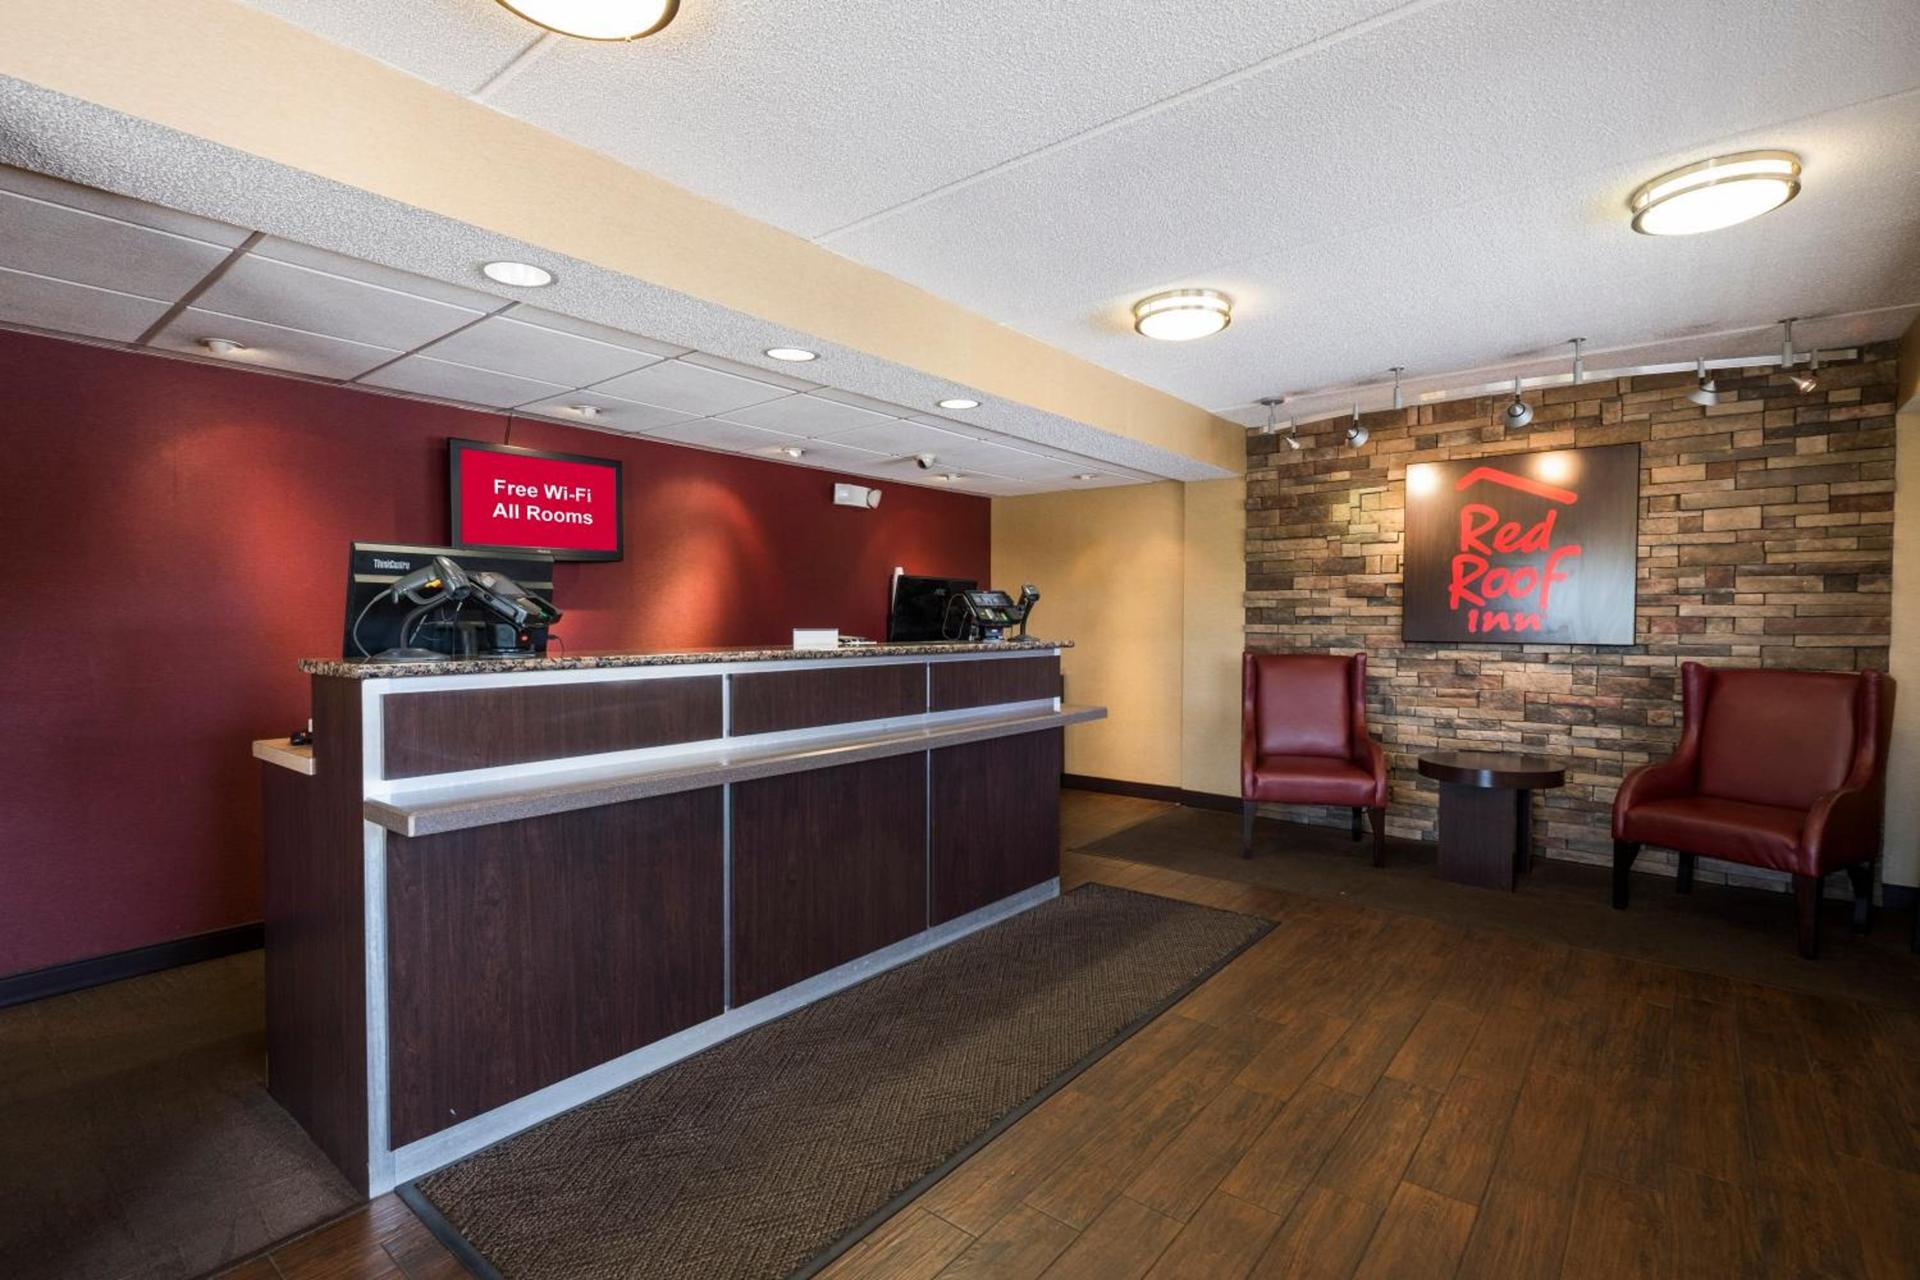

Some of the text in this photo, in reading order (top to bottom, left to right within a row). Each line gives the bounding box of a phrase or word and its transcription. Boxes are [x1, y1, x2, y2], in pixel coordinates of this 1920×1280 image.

[494, 478, 592, 503] Free Wi-Fi
[492, 502, 593, 525] All Rooms
[1460, 503, 1558, 556] Red
[1448, 544, 1582, 610] Roof
